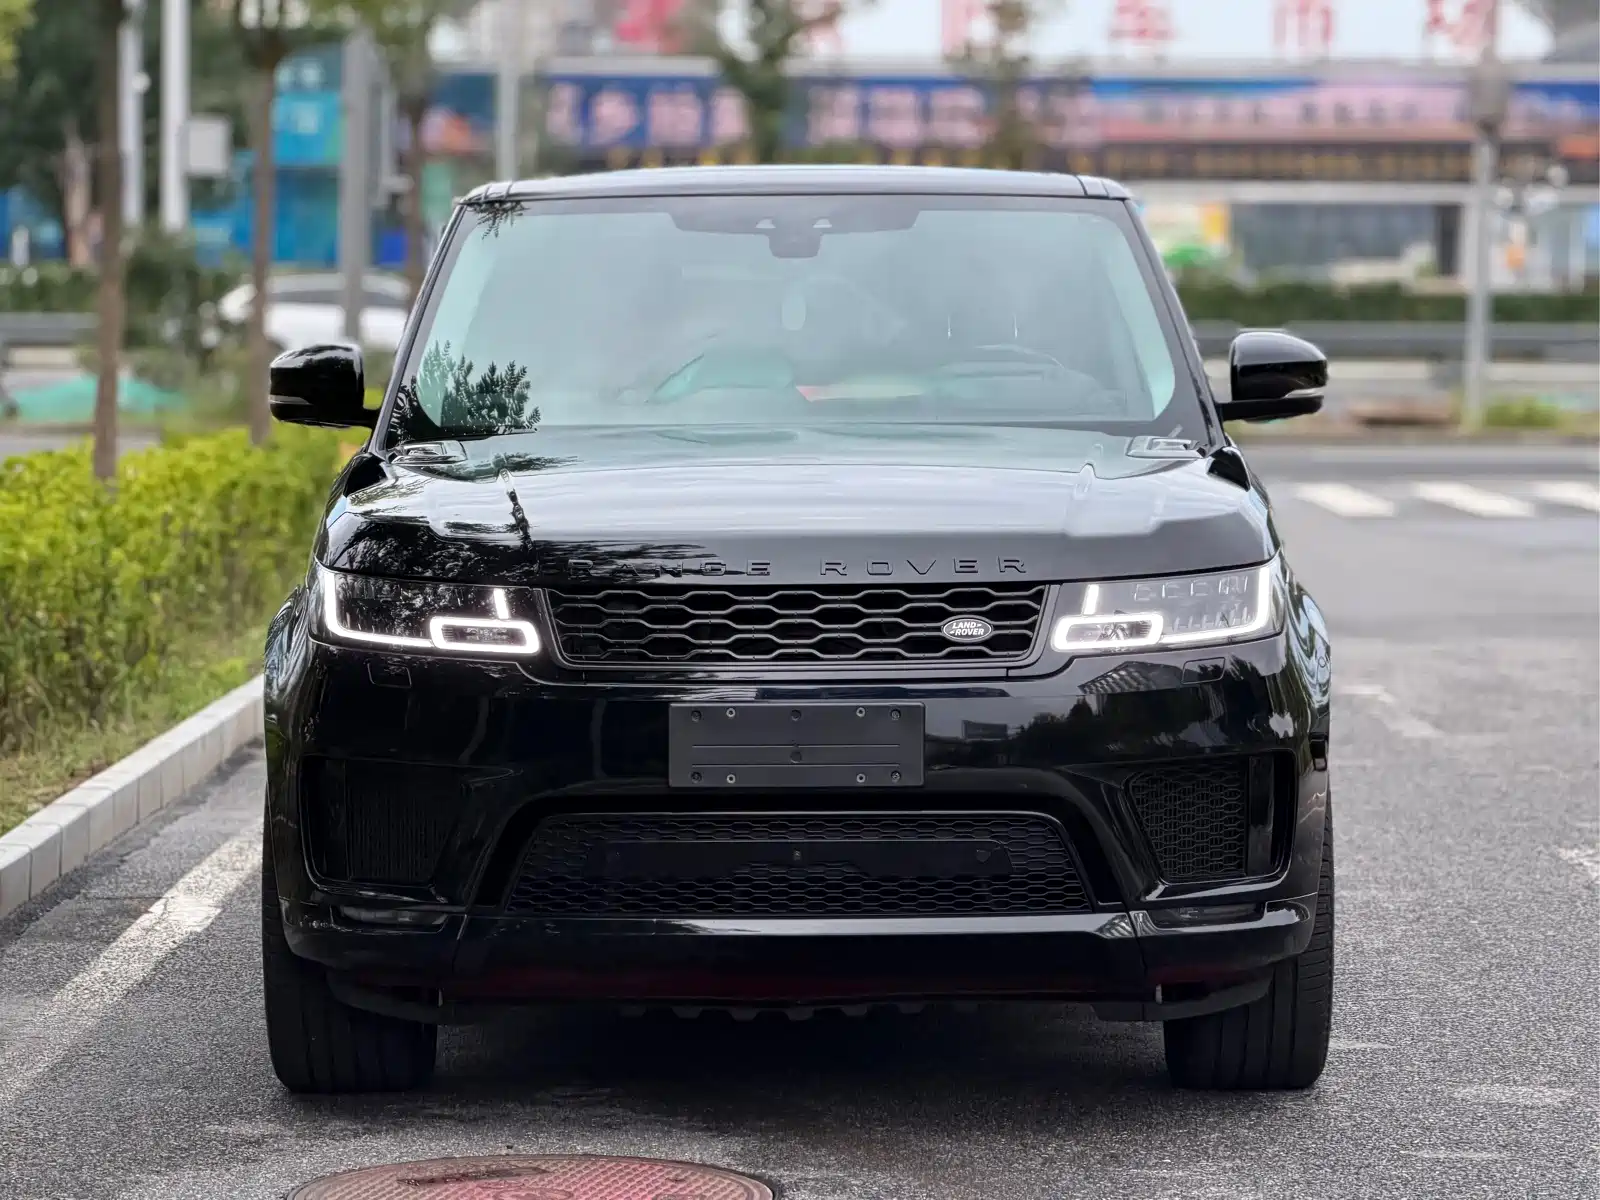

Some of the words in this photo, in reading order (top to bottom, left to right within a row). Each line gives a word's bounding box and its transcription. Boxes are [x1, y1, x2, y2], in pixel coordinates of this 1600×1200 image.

[567, 558, 771, 579] RANGE
[819, 556, 1027, 576] ROVER
[952, 621, 977, 629] LAND
[954, 628, 985, 636] ROVER
